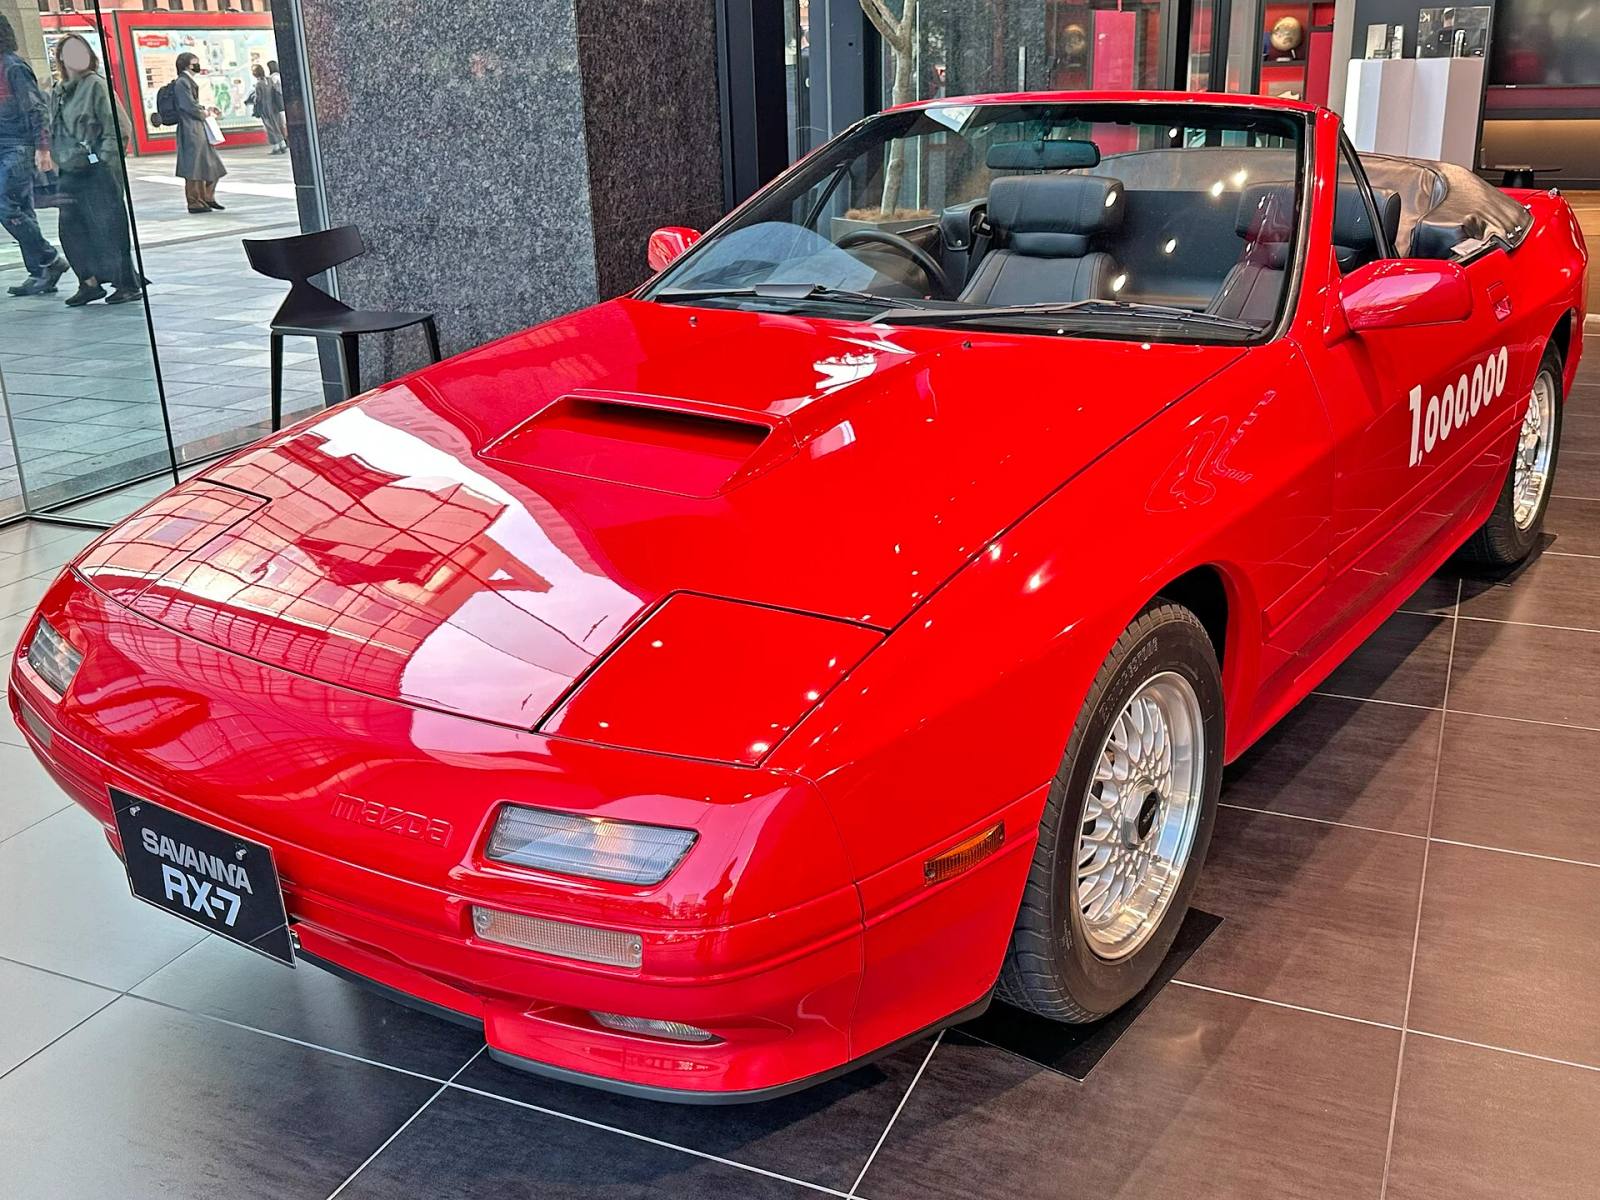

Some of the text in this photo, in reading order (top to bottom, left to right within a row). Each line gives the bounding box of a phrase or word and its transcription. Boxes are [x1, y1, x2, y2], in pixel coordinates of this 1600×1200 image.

[1409, 346, 1508, 468] 1,000,000
[141, 827, 253, 894] SAVANNA
[161, 863, 242, 927] RX-7
